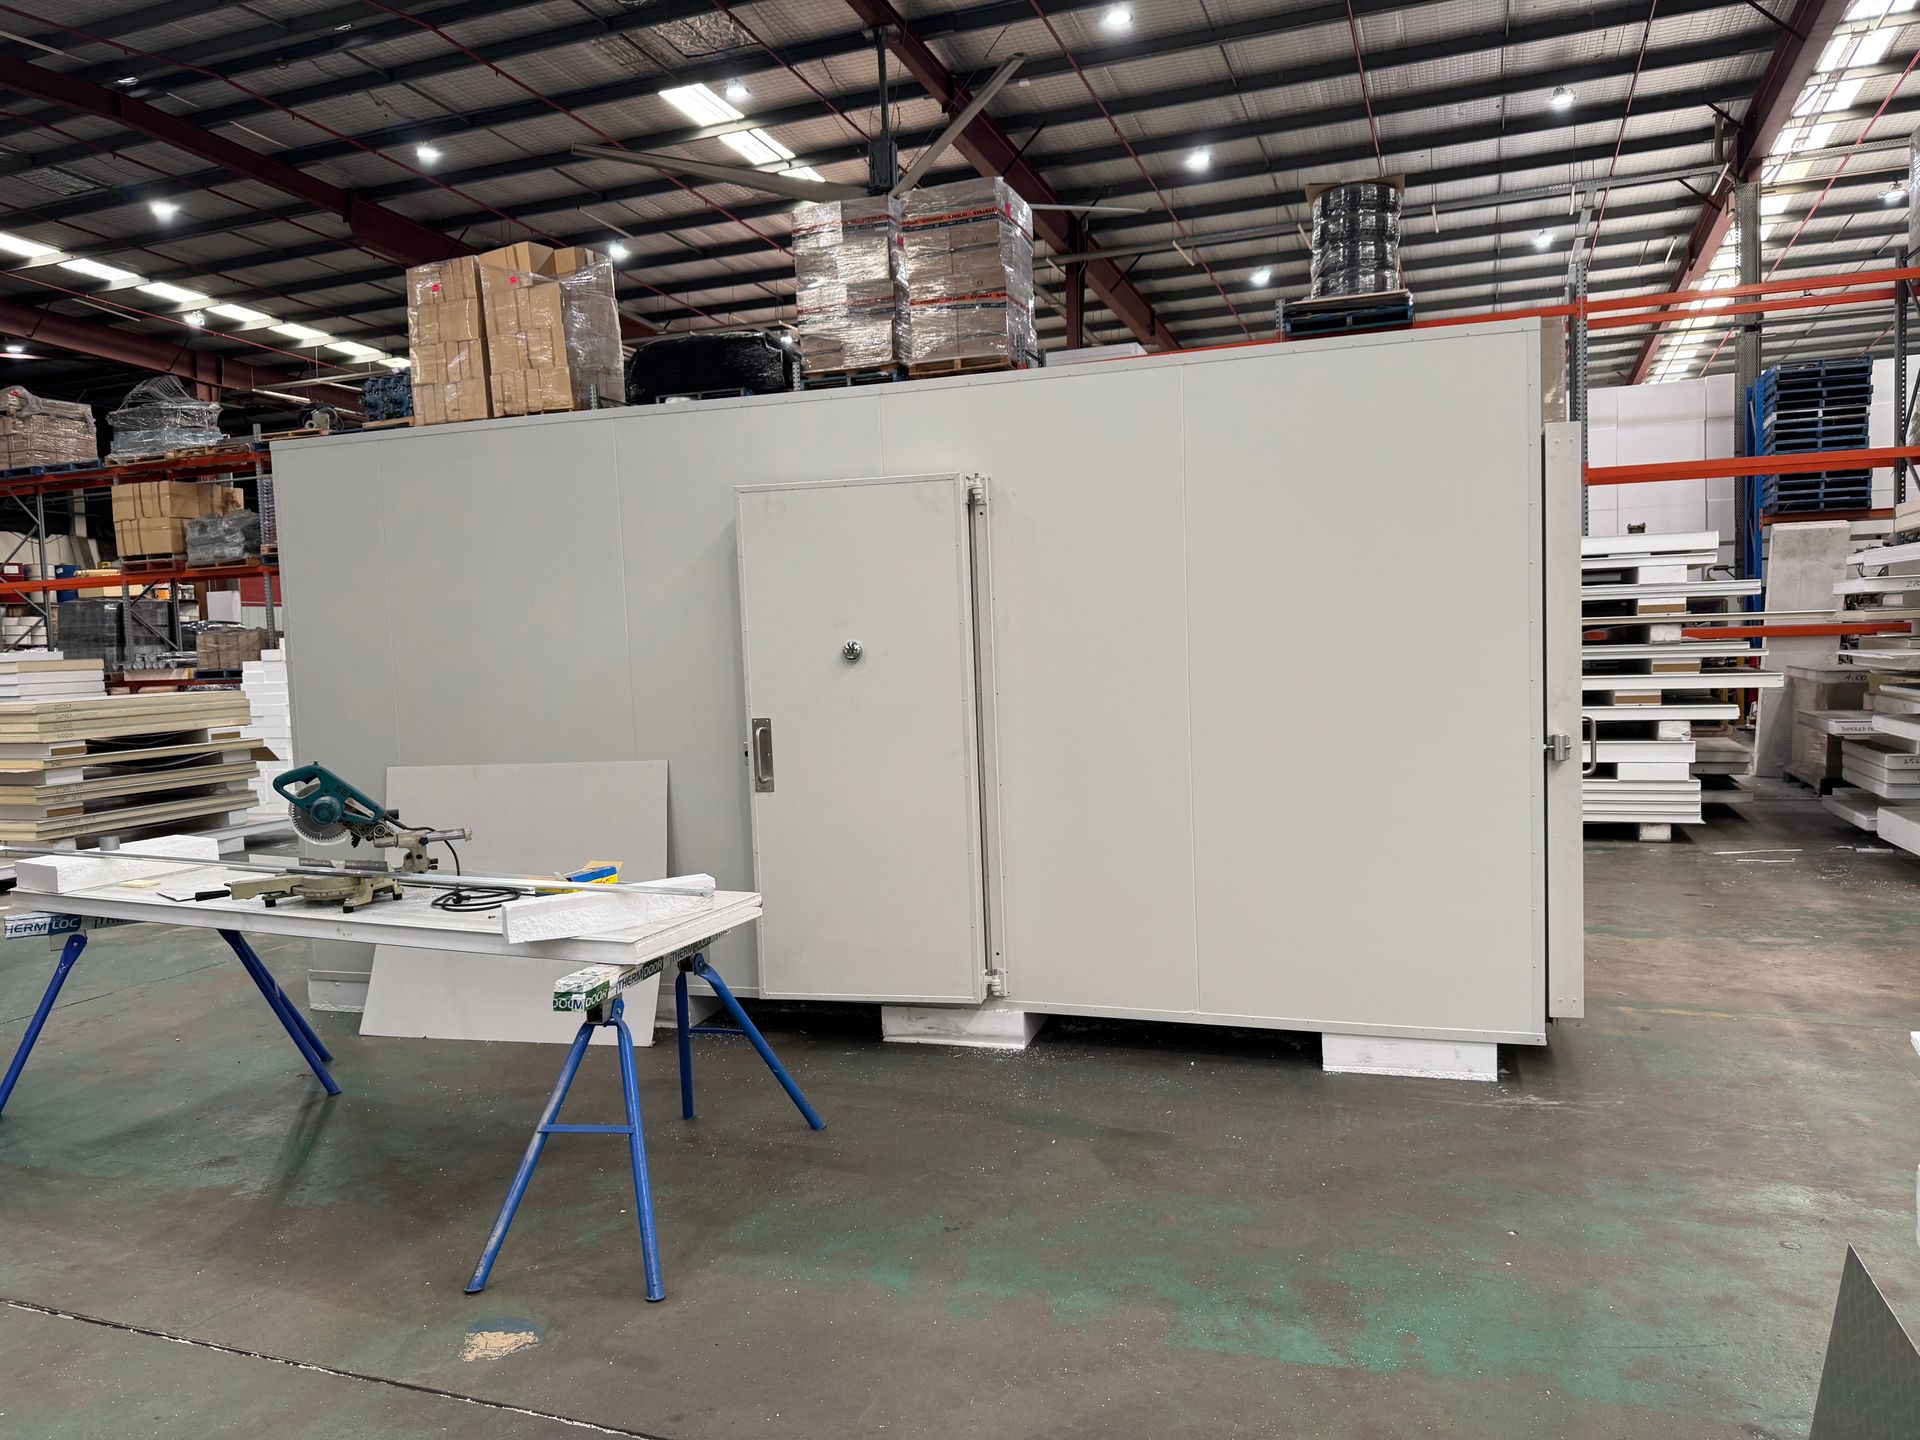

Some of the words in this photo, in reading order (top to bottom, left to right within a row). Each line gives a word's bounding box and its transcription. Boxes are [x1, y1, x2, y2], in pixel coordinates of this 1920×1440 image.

[52, 919, 78, 930] LOC
[617, 970, 643, 990] THERM
[644, 960, 662, 976] DOOR
[585, 989, 608, 1007] DOOR
